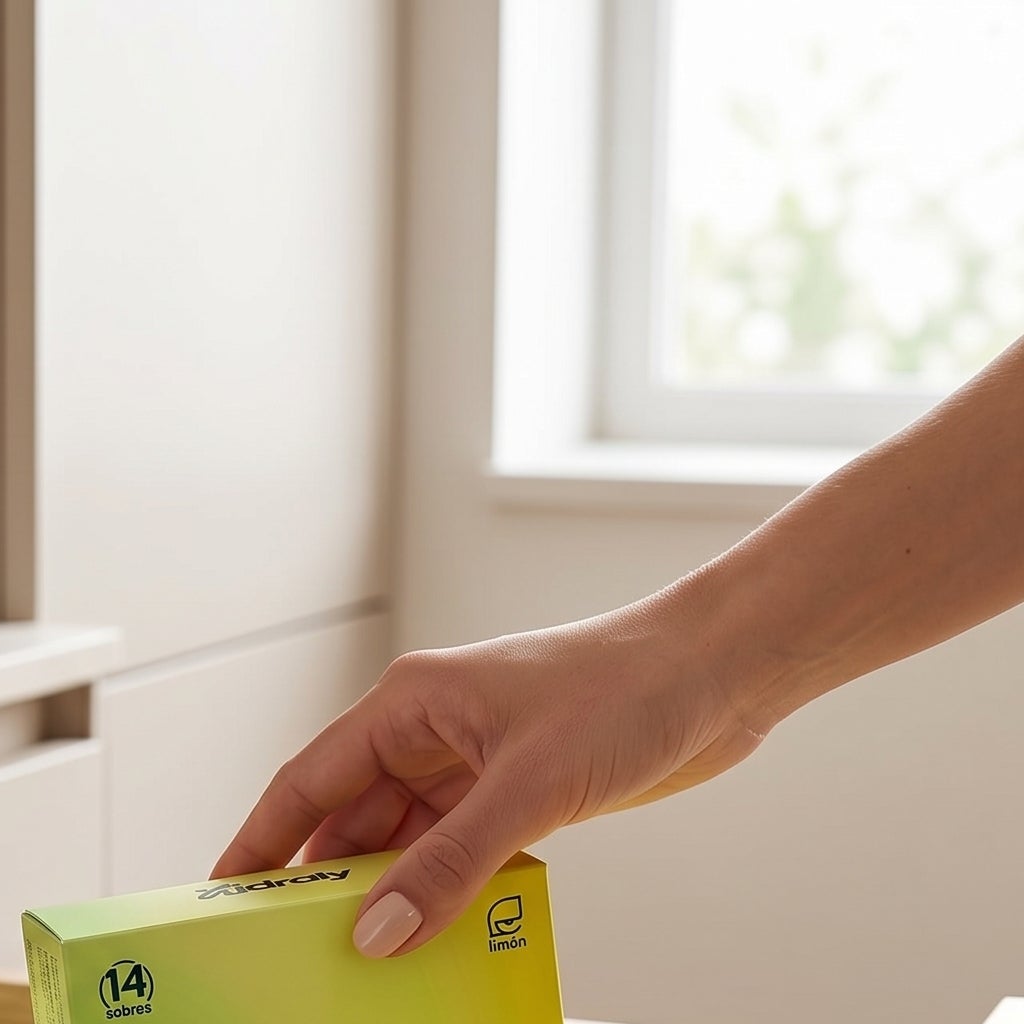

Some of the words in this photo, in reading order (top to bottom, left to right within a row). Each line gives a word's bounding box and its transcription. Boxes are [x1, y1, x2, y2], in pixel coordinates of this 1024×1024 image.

[489, 936, 527, 953] limón
[105, 963, 147, 1002] 14
[106, 1003, 153, 1020] sobres
